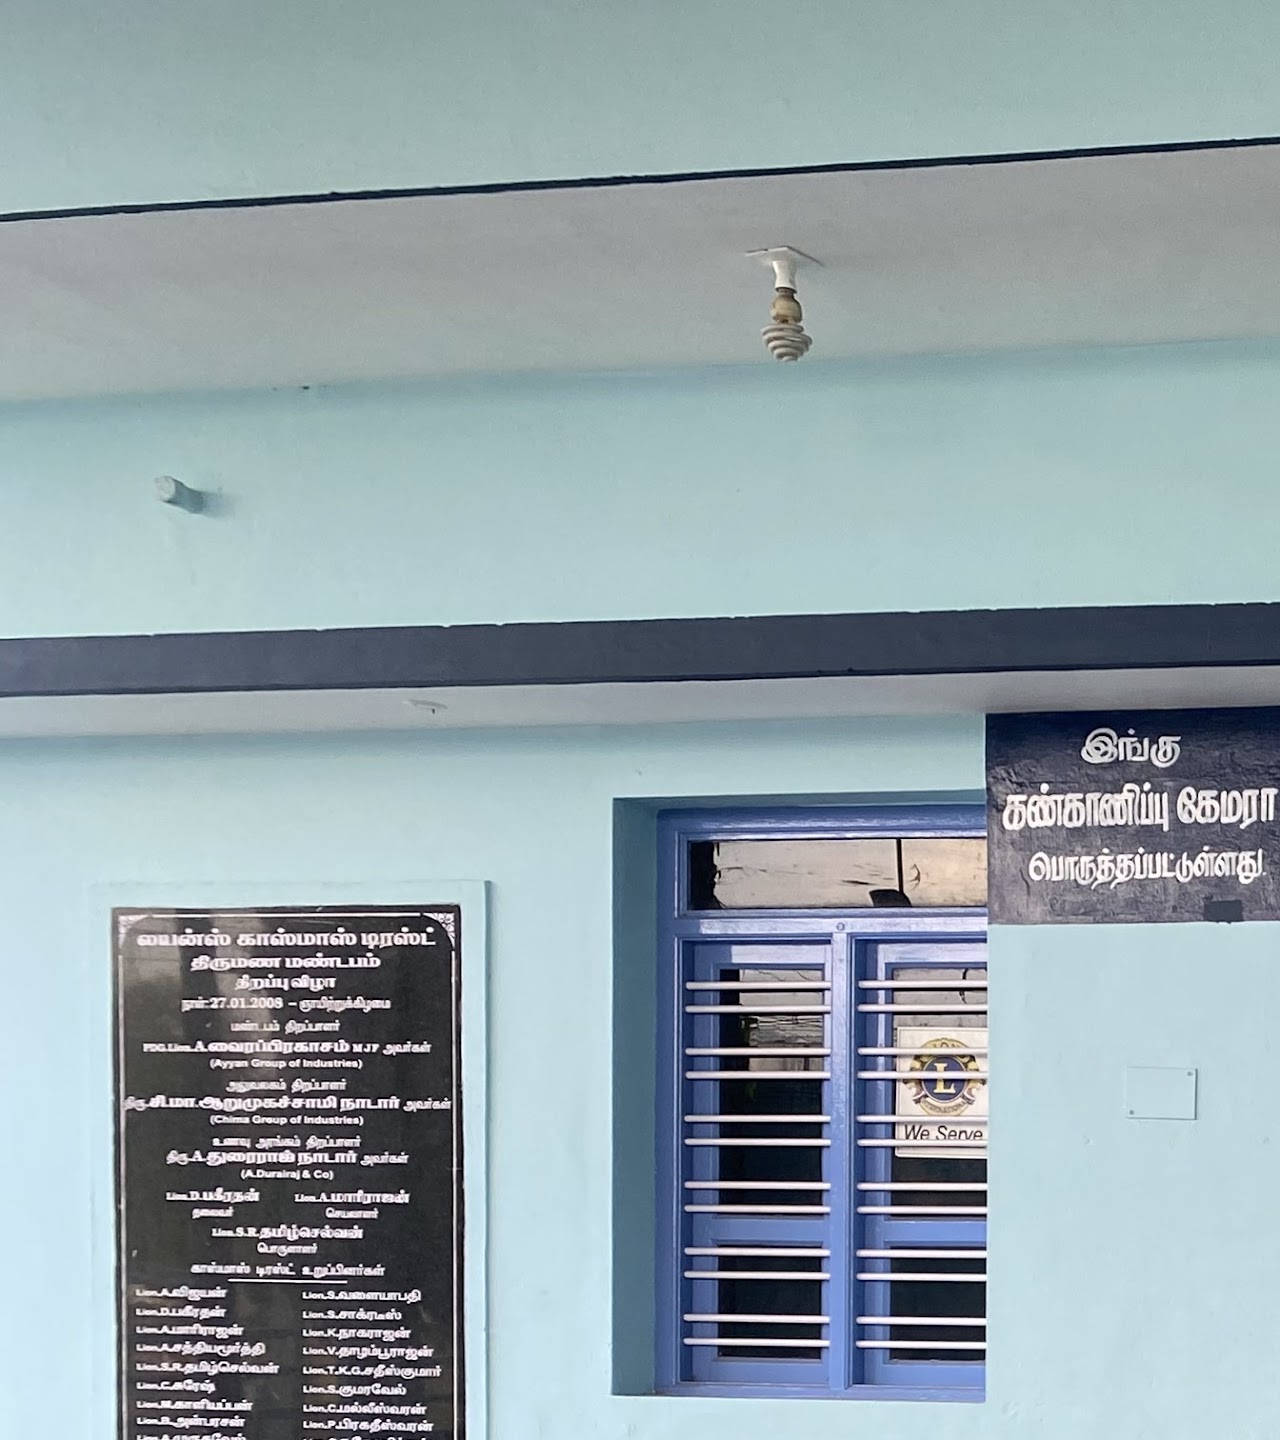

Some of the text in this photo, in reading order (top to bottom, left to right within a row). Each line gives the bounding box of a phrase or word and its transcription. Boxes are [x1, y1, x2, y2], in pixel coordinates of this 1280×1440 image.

[1080, 727, 1181, 768] இங்கு
[1001, 782, 1279, 831] கண்காணிப்பு கேமரா
[236, 926, 357, 947] காஸ்மாஸ்
[361, 926, 437, 949] டிரஸ்ட்
[190, 951, 381, 972] திருமண மண்டபம்
[234, 973, 337, 992] திறப்பு விழா
[210, 1058, 364, 1070] (Ayyan Group of Industries)
[339, 1095, 401, 1112] நாடார்
[251, 1114, 288, 1126] Group
[289, 1115, 302, 1125] of
[303, 1115, 364, 1127] Industries)
[904, 1124, 983, 1140] We Serve
[297, 1149, 358, 1166] நாடார்
[301, 1169, 311, 1179] &
[313, 1169, 335, 1180] Co)
